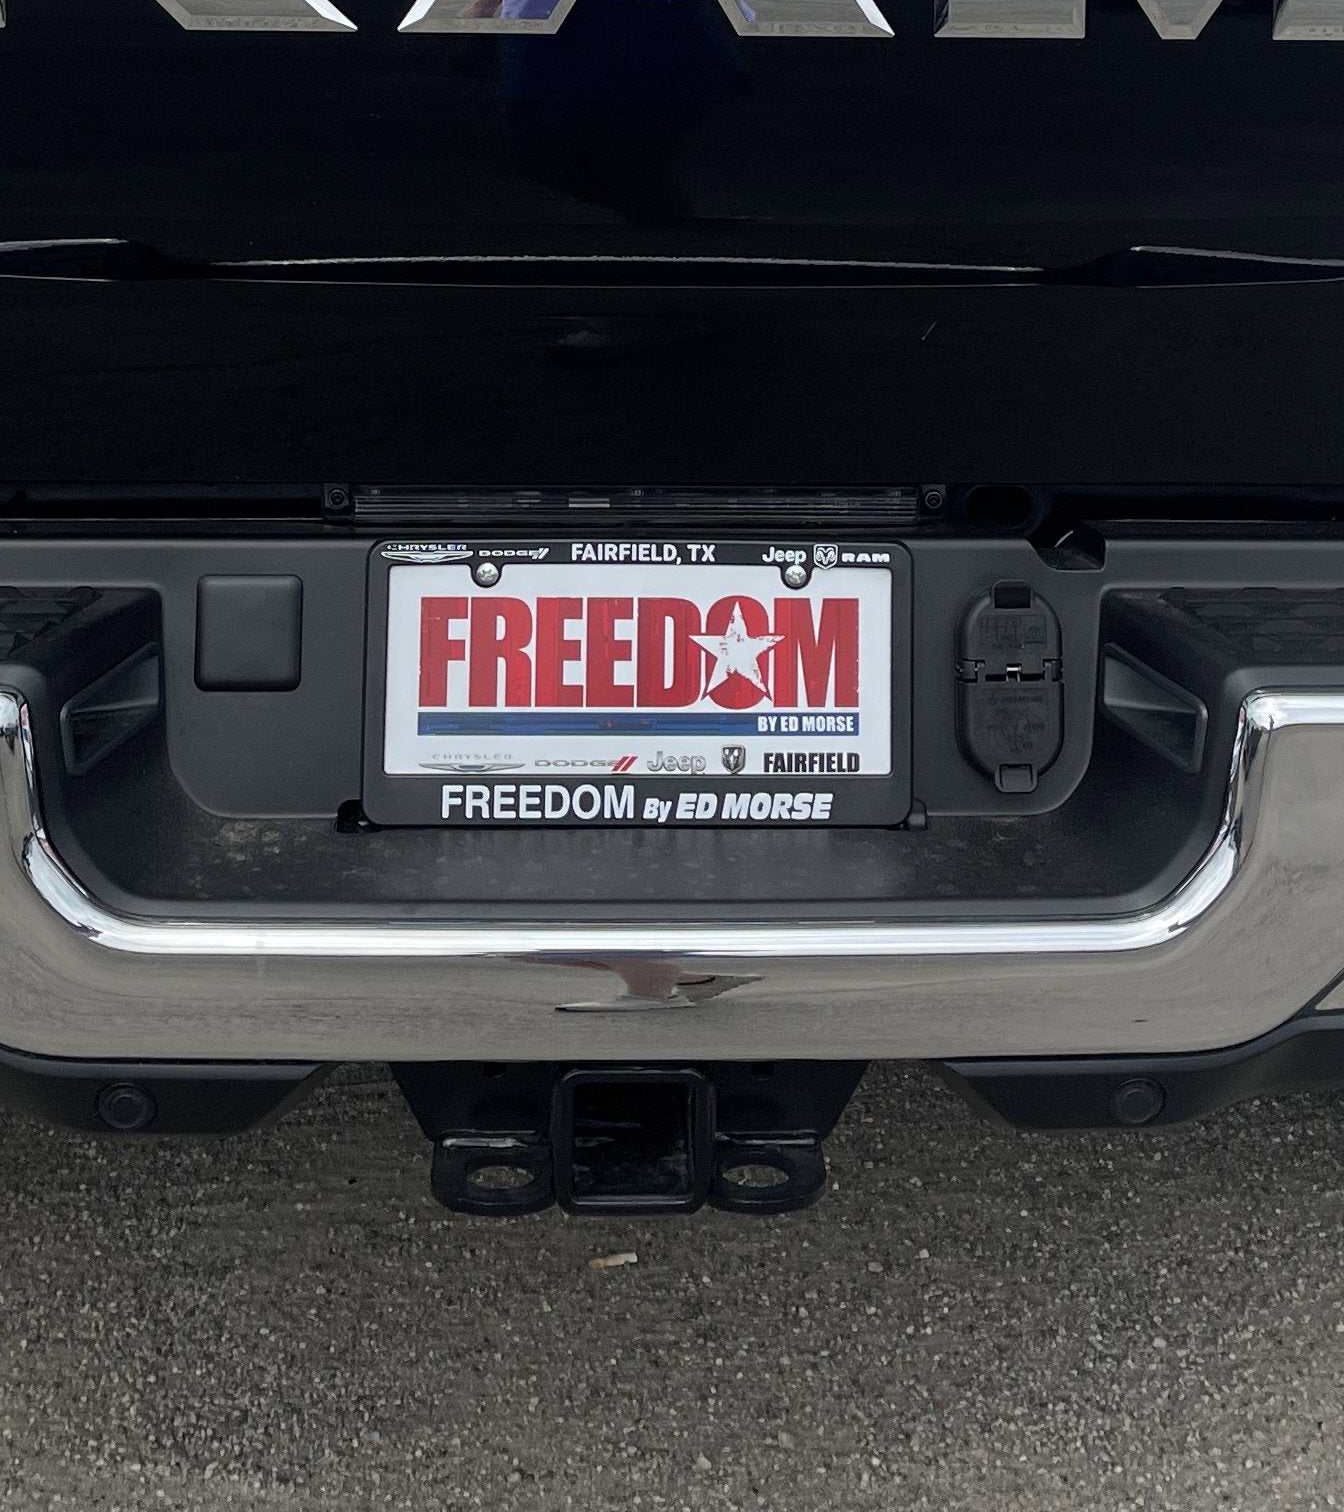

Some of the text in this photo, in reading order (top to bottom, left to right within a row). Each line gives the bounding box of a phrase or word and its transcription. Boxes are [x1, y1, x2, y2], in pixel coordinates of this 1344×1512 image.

[570, 543, 716, 565] FAIRFIELD, TX
[761, 546, 807, 565] Jeep
[841, 552, 891, 563] RAM
[418, 594, 860, 710] FREEDOM
[757, 715, 855, 732] BY ED MORSE
[646, 750, 707, 775] Jeep
[763, 752, 861, 773] FAIRFIELD
[441, 783, 636, 820] FREEDOM
[675, 792, 718, 820] ED
[721, 792, 834, 820] MORSE
